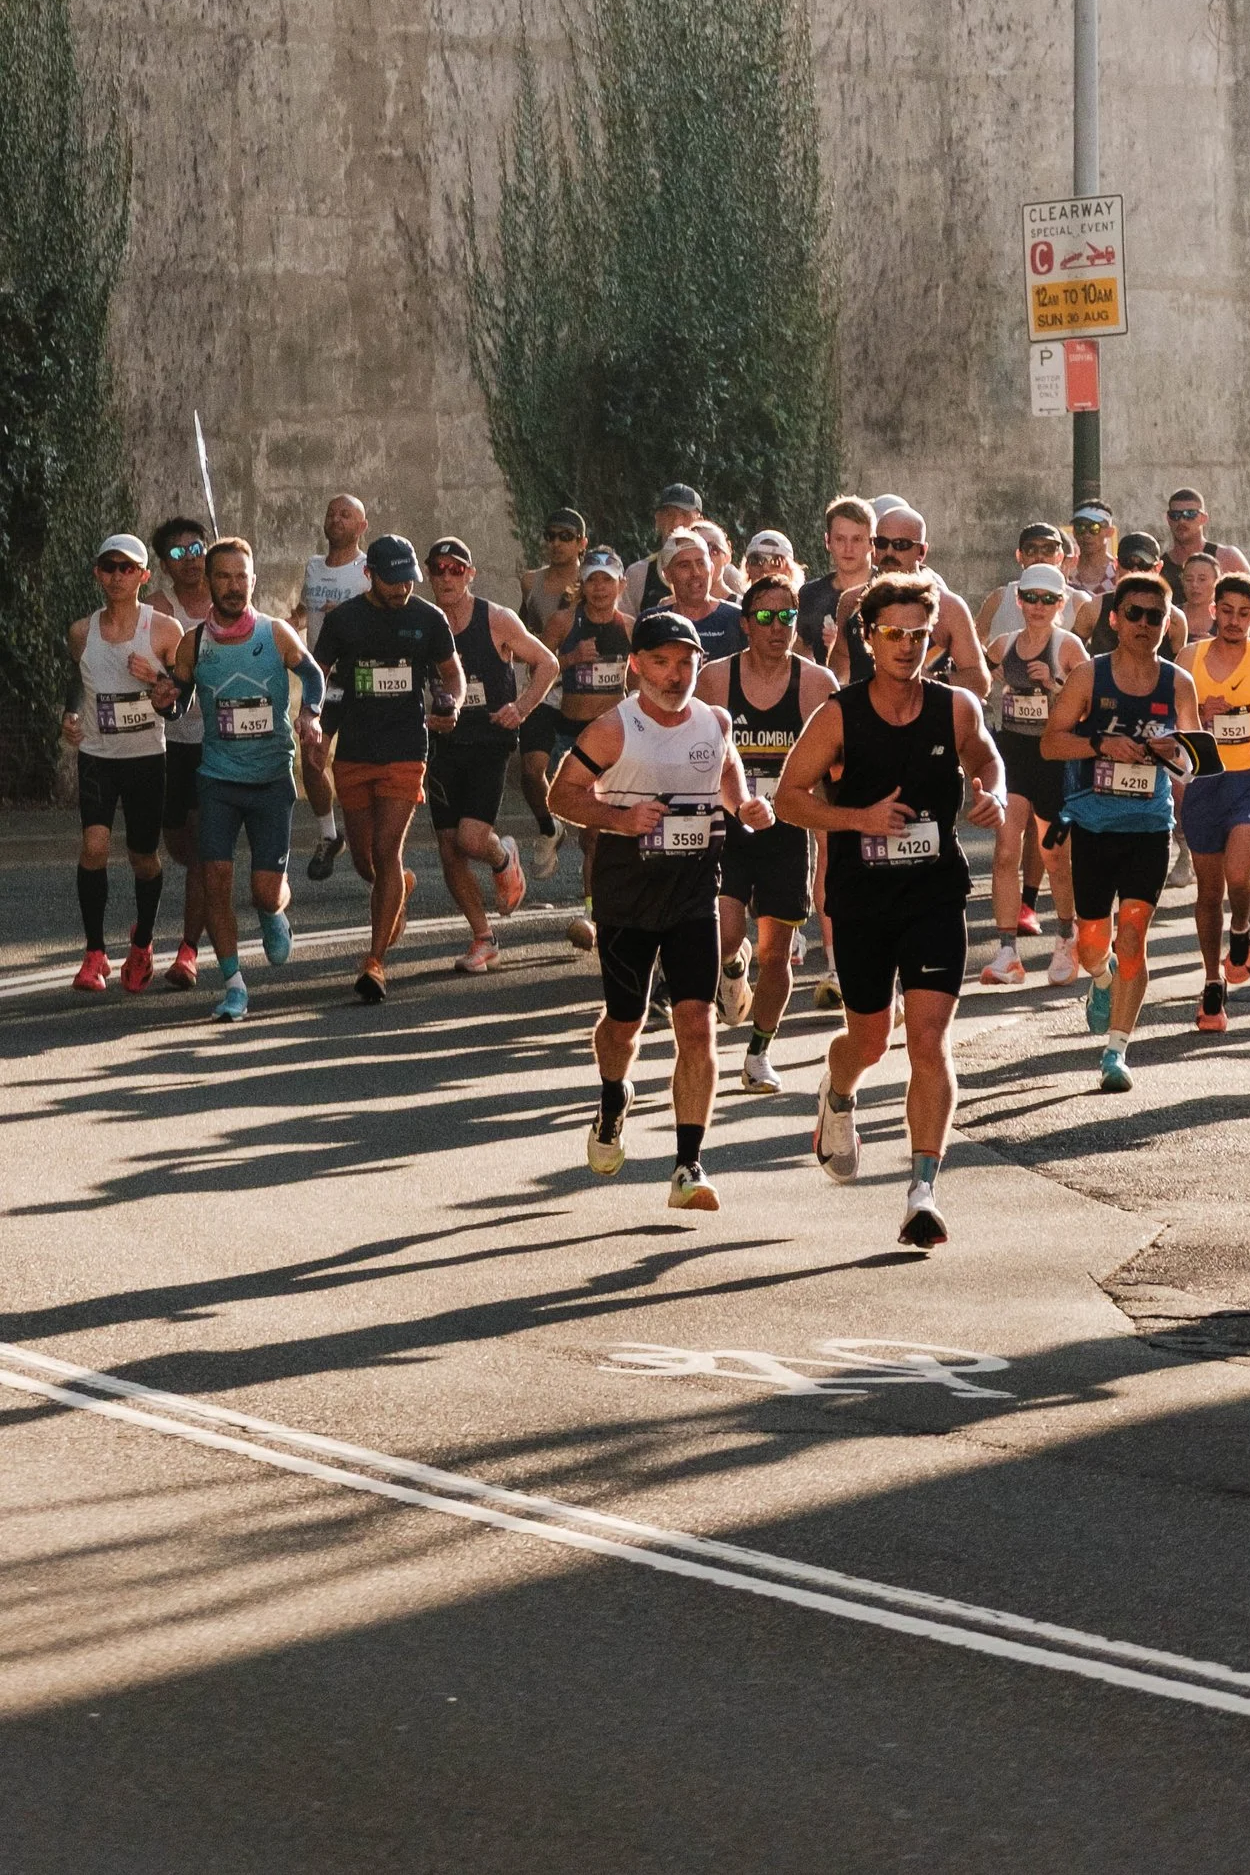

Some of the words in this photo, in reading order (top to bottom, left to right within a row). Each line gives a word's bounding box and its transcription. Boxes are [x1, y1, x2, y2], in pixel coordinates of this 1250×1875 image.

[1029, 200, 1114, 223] CLEARWAY
[1030, 225, 1073, 238] SPECIAL
[1080, 220, 1115, 234] EVENT
[1035, 244, 1048, 273] C
[1063, 289, 1078, 304] TO
[1081, 283, 1113, 305] 10AM
[1037, 312, 1063, 328] SUN
[1083, 310, 1109, 322] AUG
[1040, 349, 1053, 366] P
[378, 680, 407, 690] 11230
[122, 713, 147, 725] 1503
[1018, 706, 1043, 717] 3028
[733, 730, 795, 747] COLOMBIA
[1221, 726, 1246, 737] 3521
[689, 750, 710, 761] KRC
[1120, 777, 1148, 790] 4218
[654, 835, 662, 846] B
[672, 832, 704, 846] 3599
[865, 846, 871, 857] 1
[877, 846, 886, 857] B
[897, 840, 931, 855] 4120
